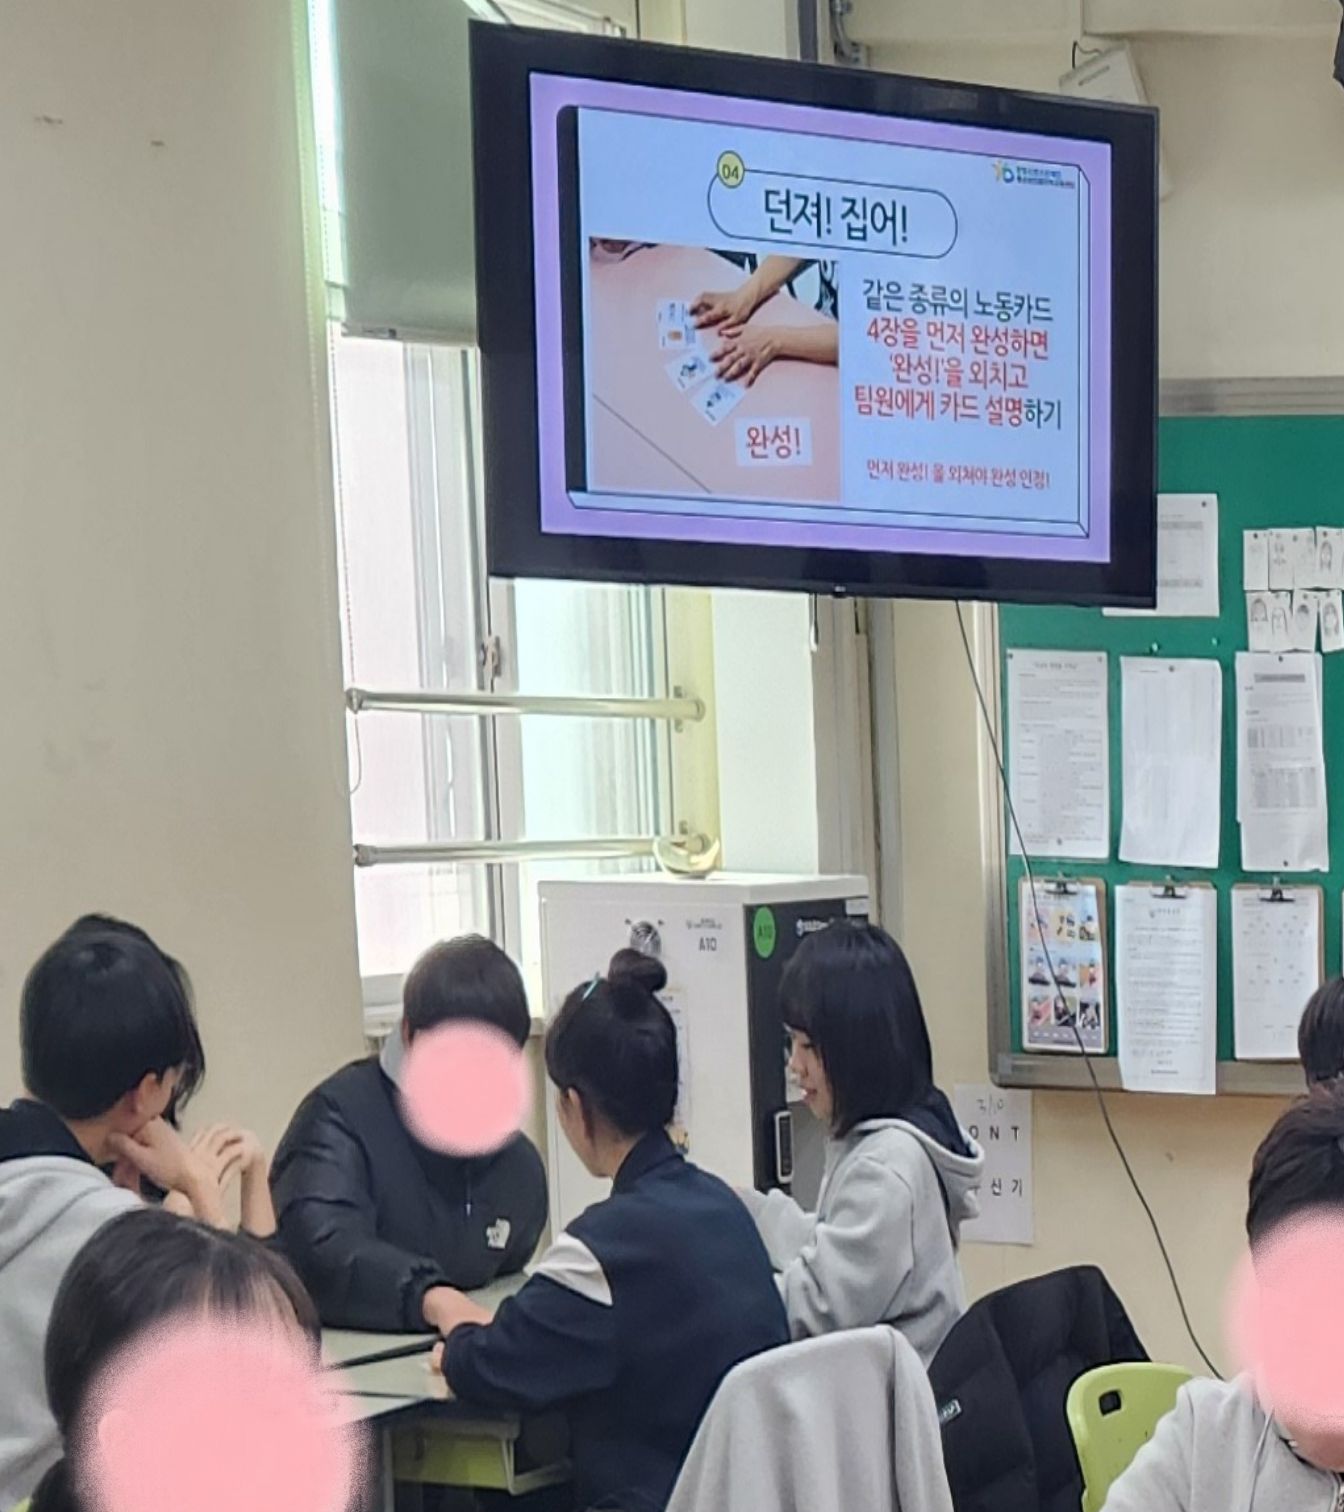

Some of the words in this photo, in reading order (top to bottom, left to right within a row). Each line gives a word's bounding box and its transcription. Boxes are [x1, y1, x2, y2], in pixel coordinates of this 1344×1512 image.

[722, 164, 739, 180] 04
[764, 188, 831, 238] 던져!
[841, 196, 907, 246] 집어!
[863, 279, 904, 312] 같은
[909, 283, 968, 319] 종류의
[974, 290, 1053, 324] 노동카드
[867, 316, 920, 349] 4장을
[927, 321, 964, 353] 먼저
[971, 324, 1048, 360] 완성하면
[969, 359, 1028, 391] 외치고
[855, 385, 934, 421] 팀원에게
[940, 391, 980, 421] 카드
[986, 394, 1061, 430] 설명하기
[747, 425, 801, 460] 완성!
[868, 458, 893, 481] 먼저
[897, 461, 928, 482] 완성!
[991, 468, 1016, 488] 완성
[699, 937, 716, 951] A10
